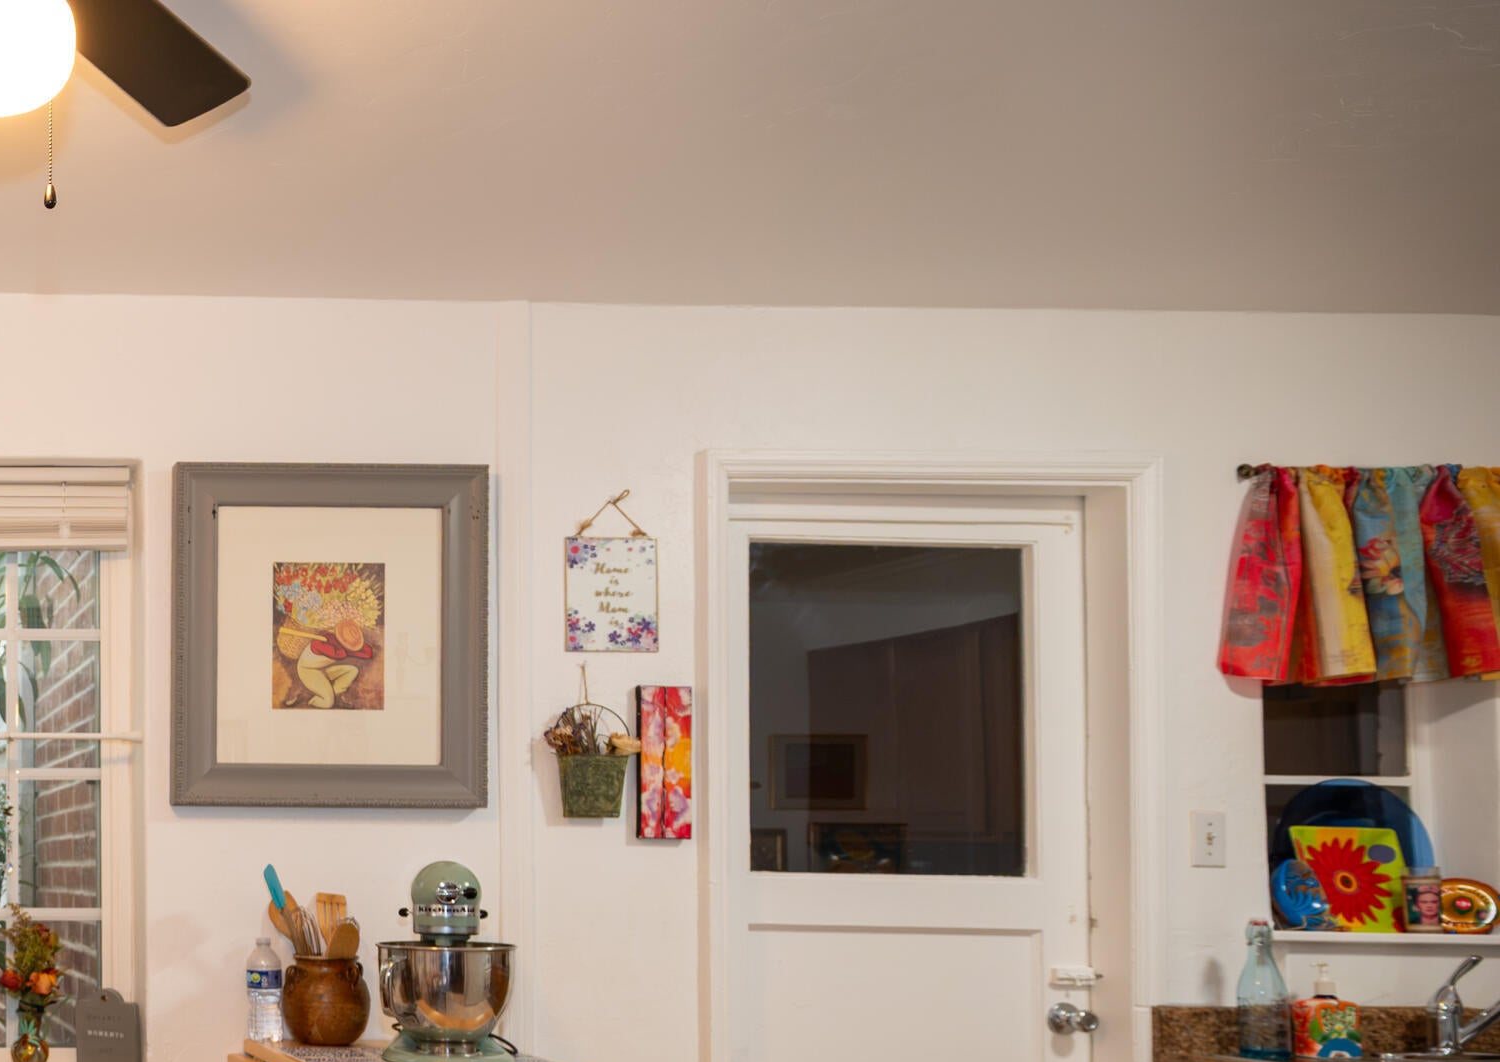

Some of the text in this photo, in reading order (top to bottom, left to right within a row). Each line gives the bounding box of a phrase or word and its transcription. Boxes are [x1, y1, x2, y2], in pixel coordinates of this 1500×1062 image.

[594, 562, 629, 574] Home
[609, 576, 619, 585] is
[594, 587, 631, 597] where
[598, 601, 629, 613] Mom
